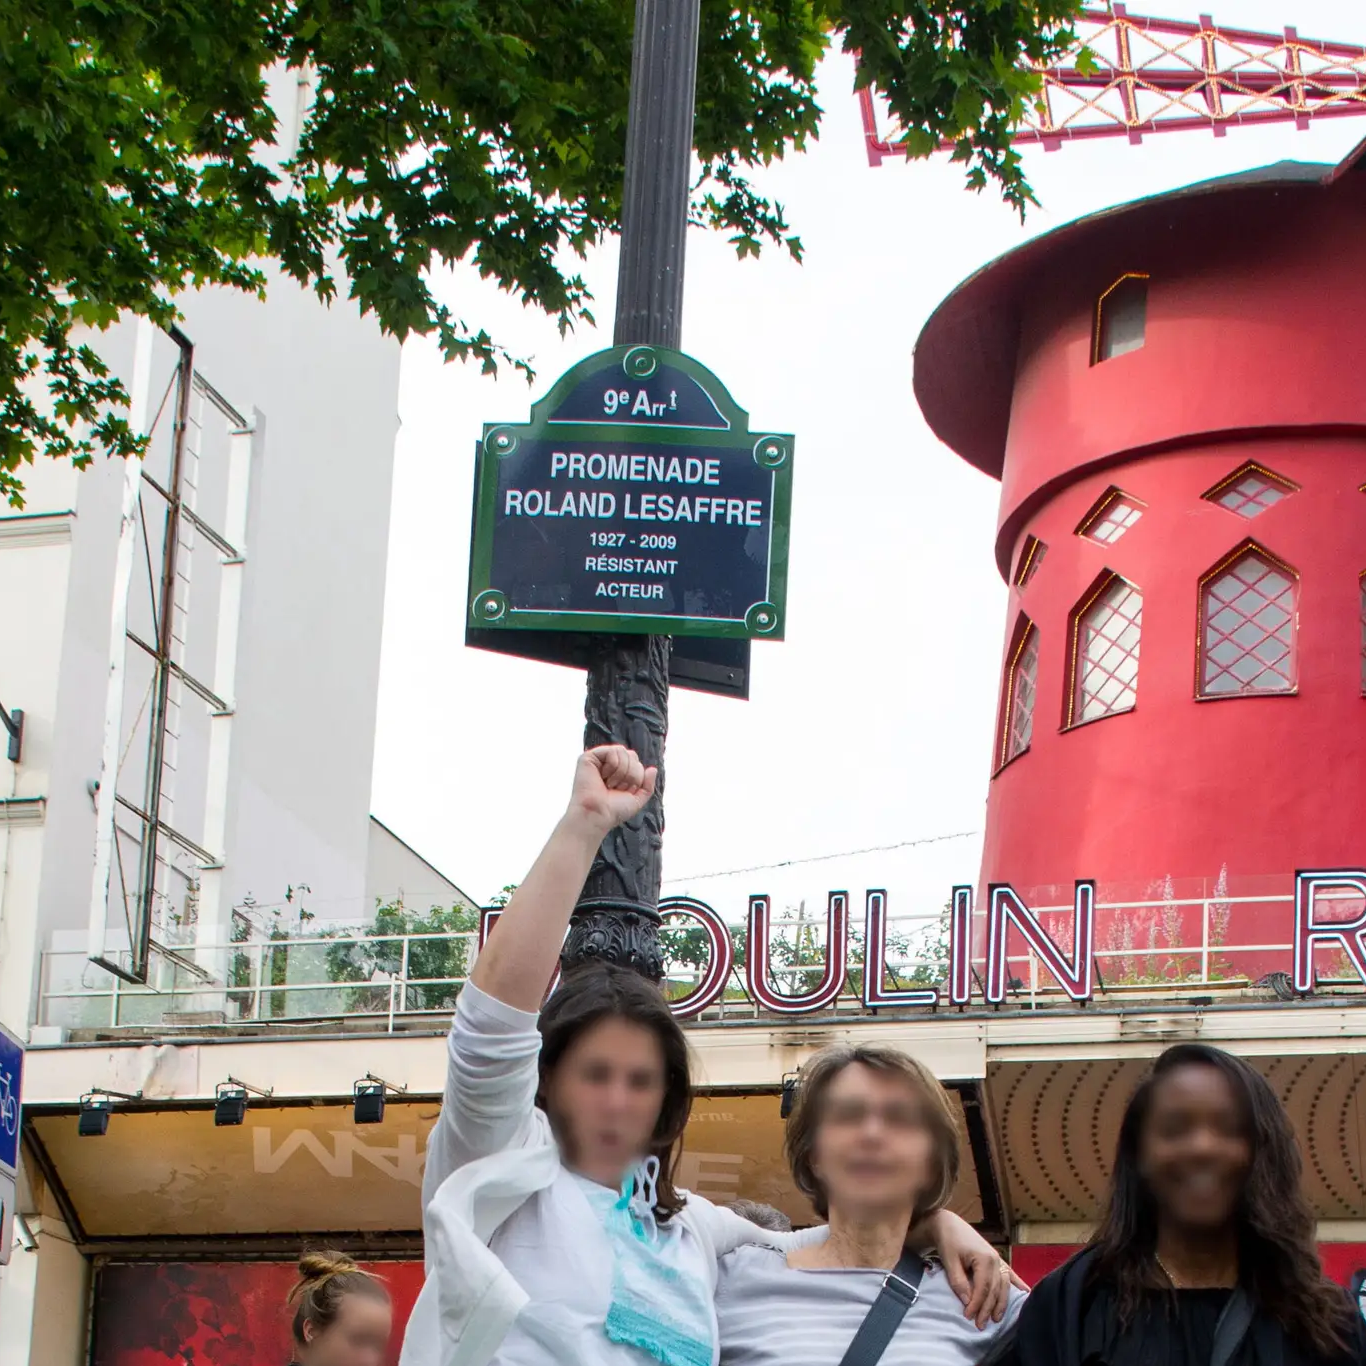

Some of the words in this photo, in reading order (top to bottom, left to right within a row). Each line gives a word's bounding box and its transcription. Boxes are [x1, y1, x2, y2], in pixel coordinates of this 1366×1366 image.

[550, 452, 721, 485] PROMENADE
[504, 489, 616, 520] ROLAND
[624, 493, 762, 526] LESAFFRE
[590, 532, 626, 548] 1927
[640, 534, 677, 549] 2009
[585, 553, 678, 575] RÉSISTANT
[595, 583, 664, 599] ACTEUR
[479, 878, 1097, 1018] OULIN
